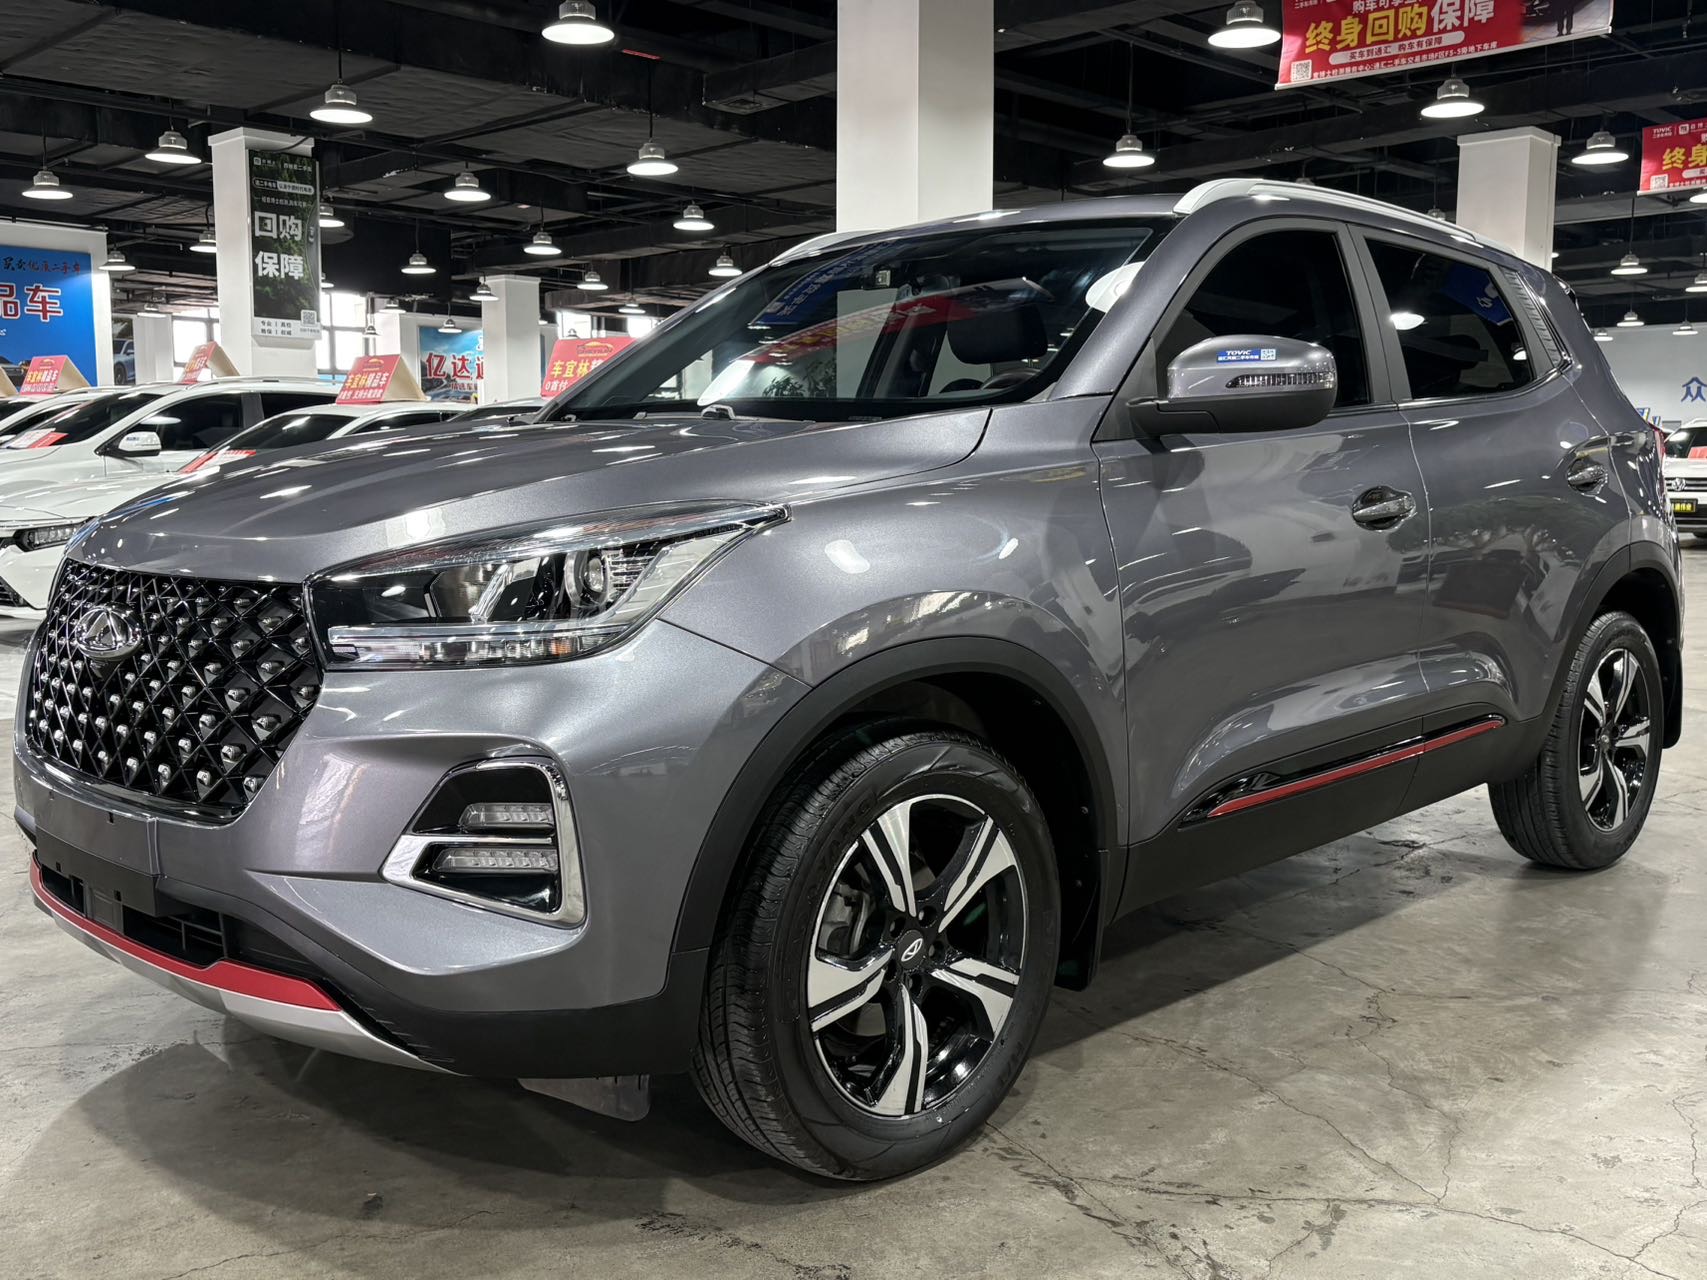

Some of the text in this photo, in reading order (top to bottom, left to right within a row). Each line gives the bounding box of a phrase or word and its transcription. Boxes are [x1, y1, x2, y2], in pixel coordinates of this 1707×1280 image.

[254, 211, 302, 241] 回购
[255, 251, 304, 280] 保障
[426, 352, 484, 380] 亿达
[345, 372, 390, 389] 车宜林精品车
[1681, 376, 1707, 402] 众
